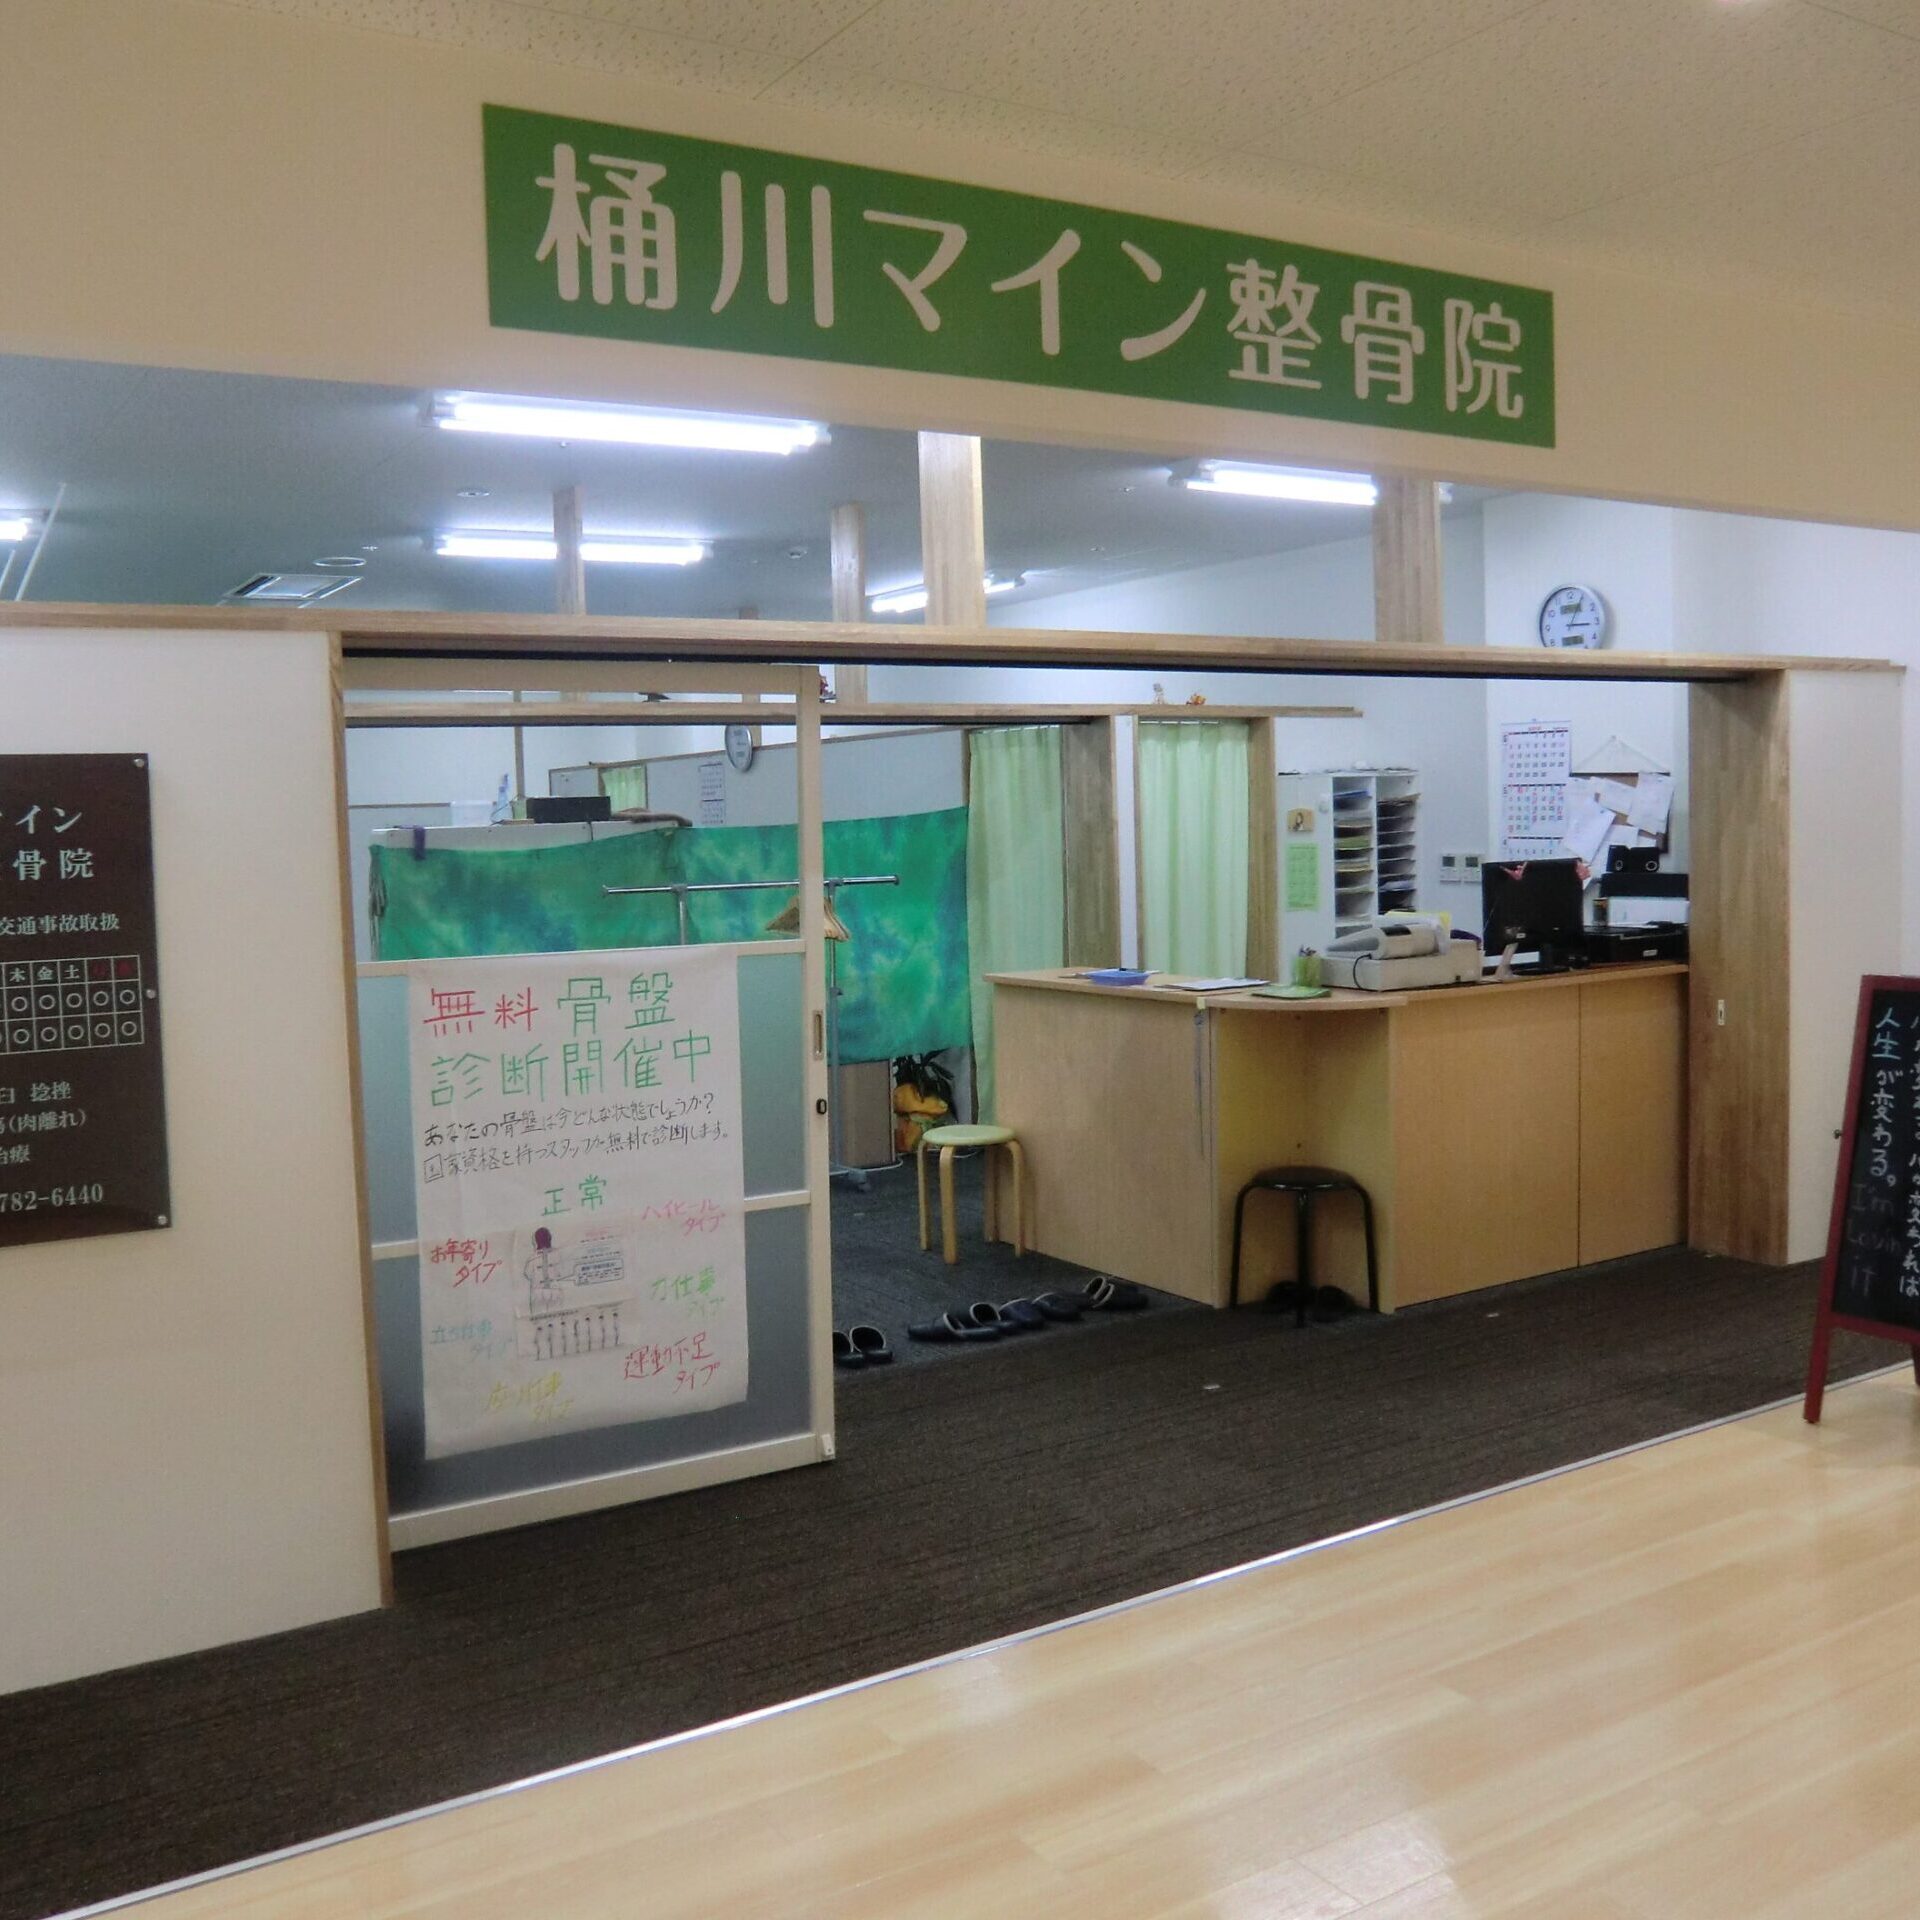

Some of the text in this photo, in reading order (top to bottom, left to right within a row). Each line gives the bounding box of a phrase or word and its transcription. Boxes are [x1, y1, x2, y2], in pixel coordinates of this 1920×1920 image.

[534, 142, 1525, 420] 桶川マイン整骨院
[0, 803, 83, 836] イン
[36, 965, 54, 982] 金
[64, 963, 80, 980] 土
[431, 1029, 712, 1107] 診断開催中
[0, 1108, 88, 1135] （肉離れ）
[540, 1173, 607, 1217] 正常
[453, 1259, 503, 1289] タイプ
[672, 1361, 721, 1395] タイプ
